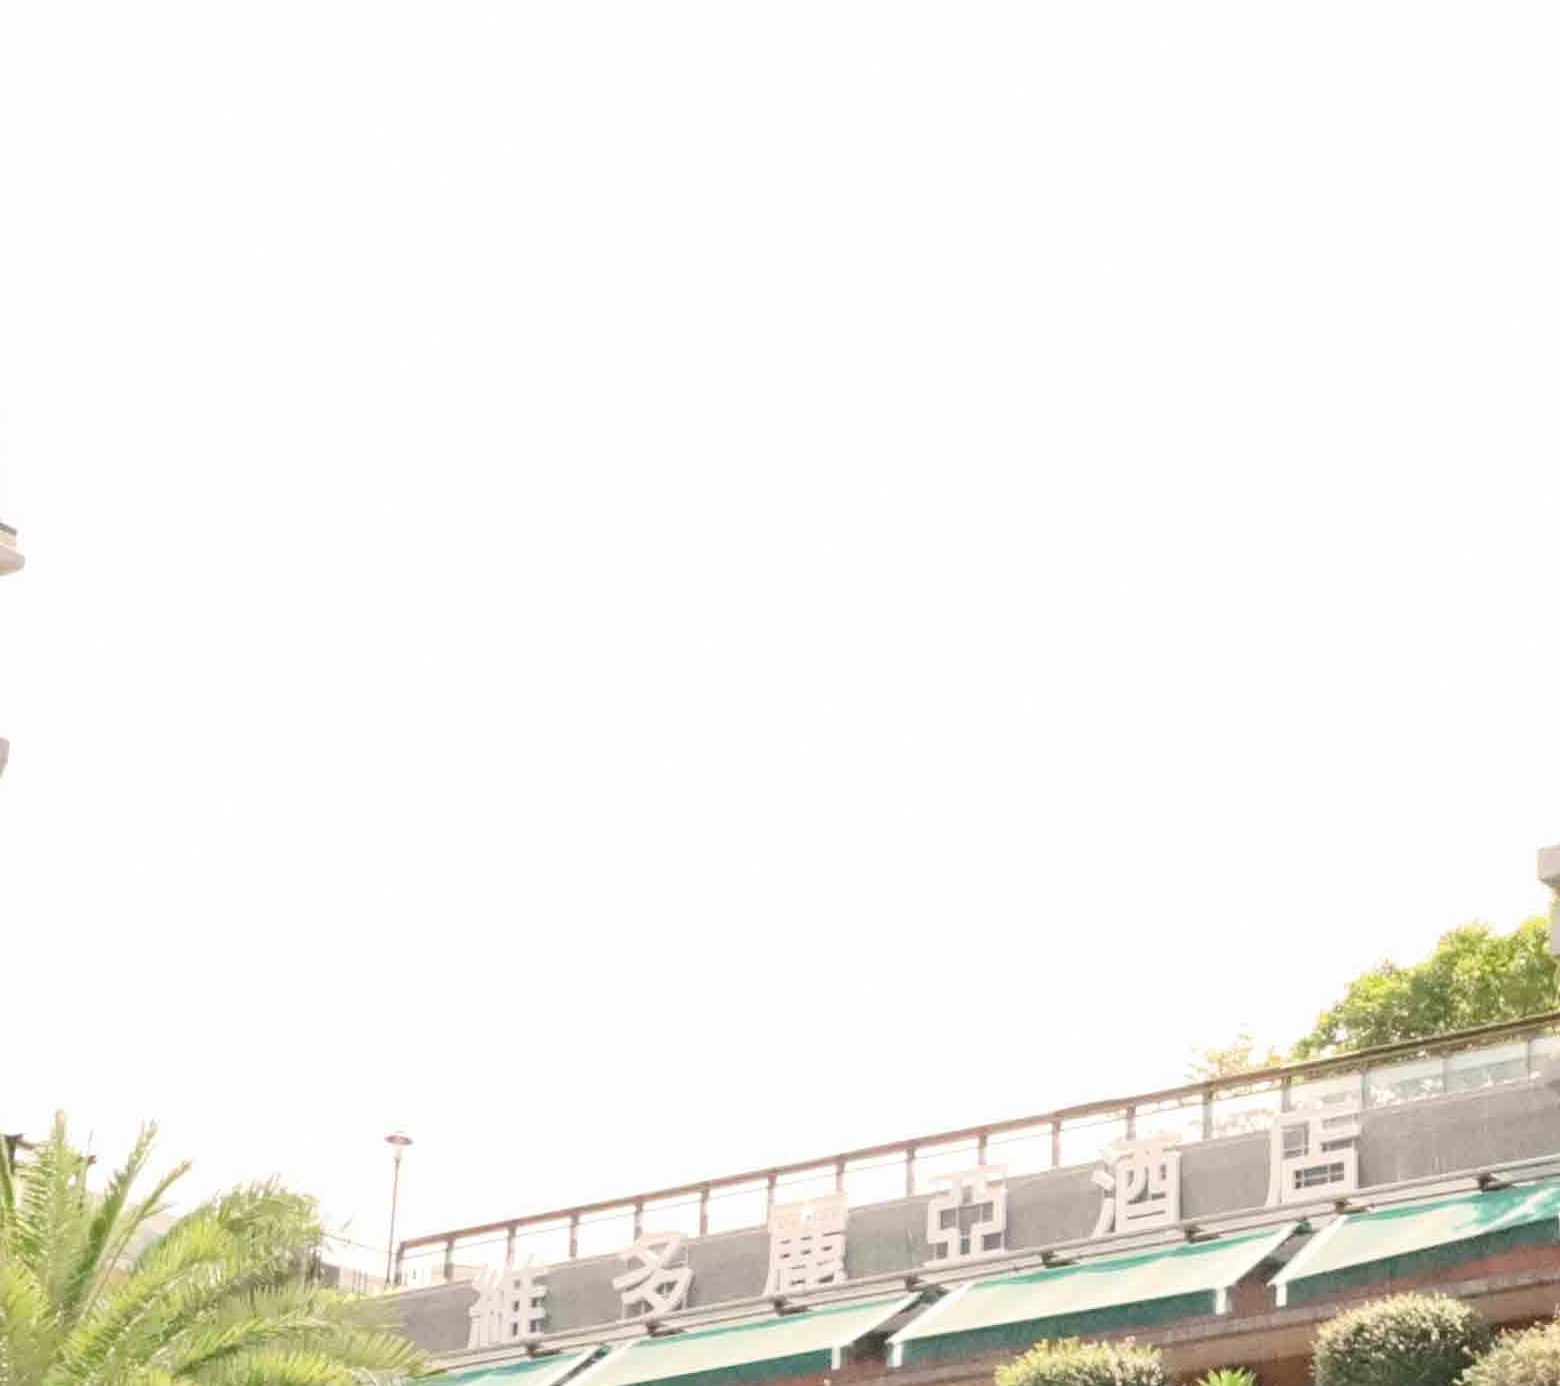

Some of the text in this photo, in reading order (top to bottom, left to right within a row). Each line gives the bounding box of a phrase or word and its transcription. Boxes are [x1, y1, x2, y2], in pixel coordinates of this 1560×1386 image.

[467, 1097, 1363, 1351] 維多麗亞酒店
